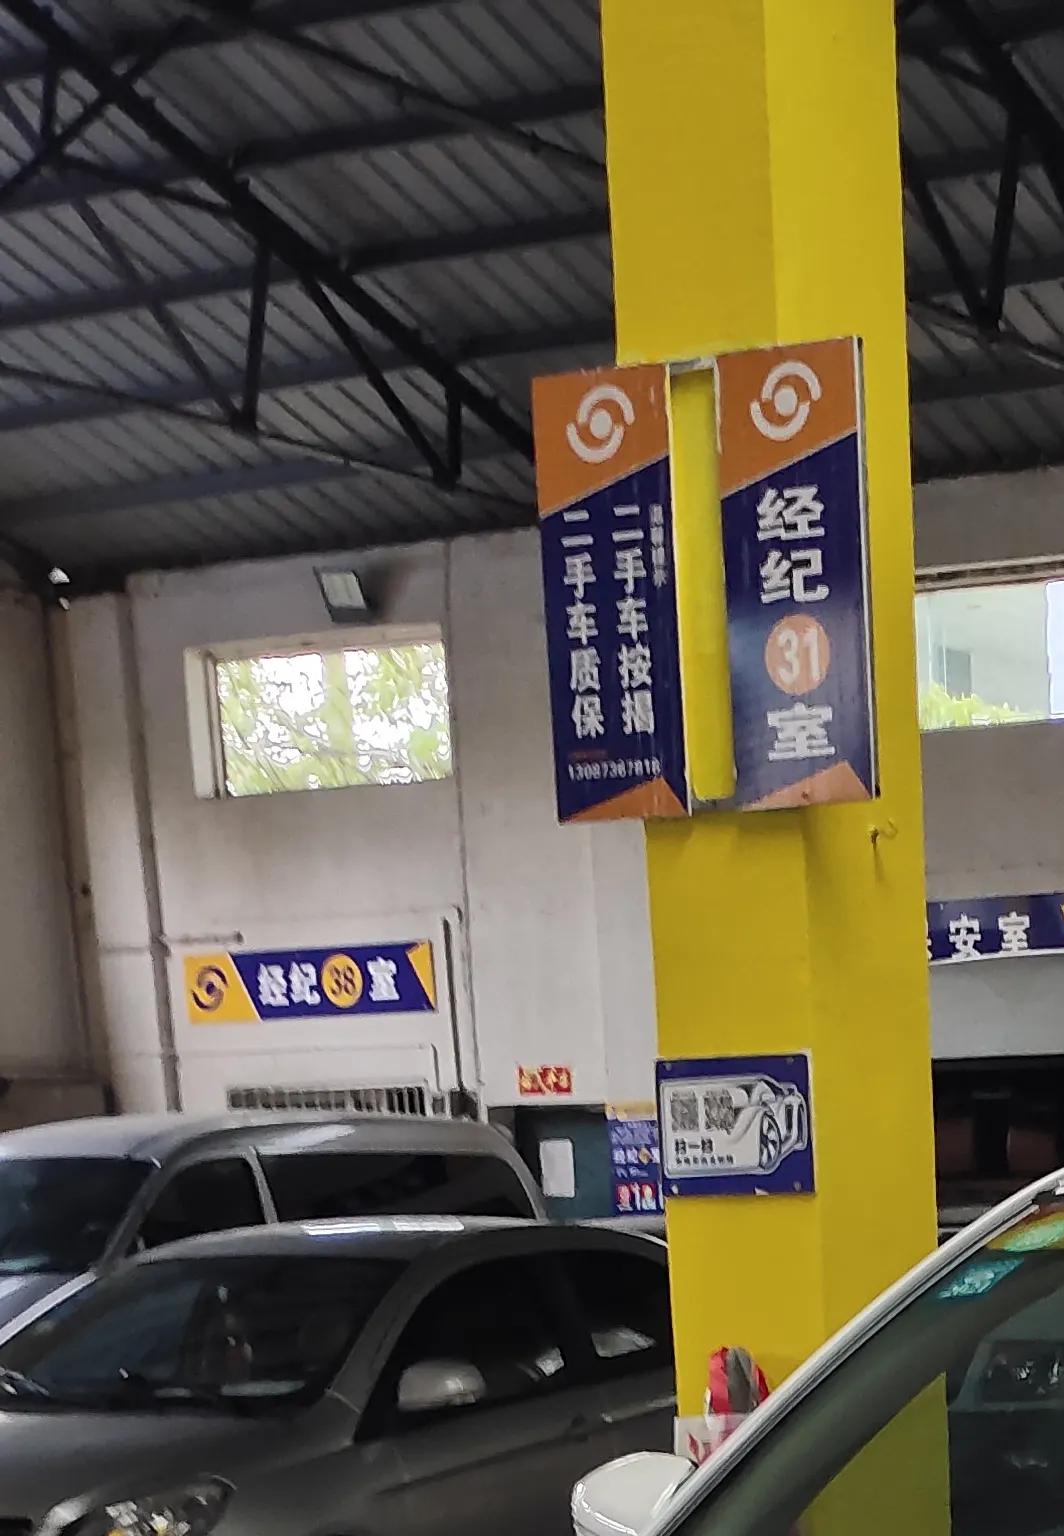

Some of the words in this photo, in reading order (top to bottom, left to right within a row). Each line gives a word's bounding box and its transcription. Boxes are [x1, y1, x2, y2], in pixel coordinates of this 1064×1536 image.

[560, 508, 605, 739] 二手车质保
[611, 502, 655, 735] 二手车按揭
[756, 483, 836, 761] 经纪31室
